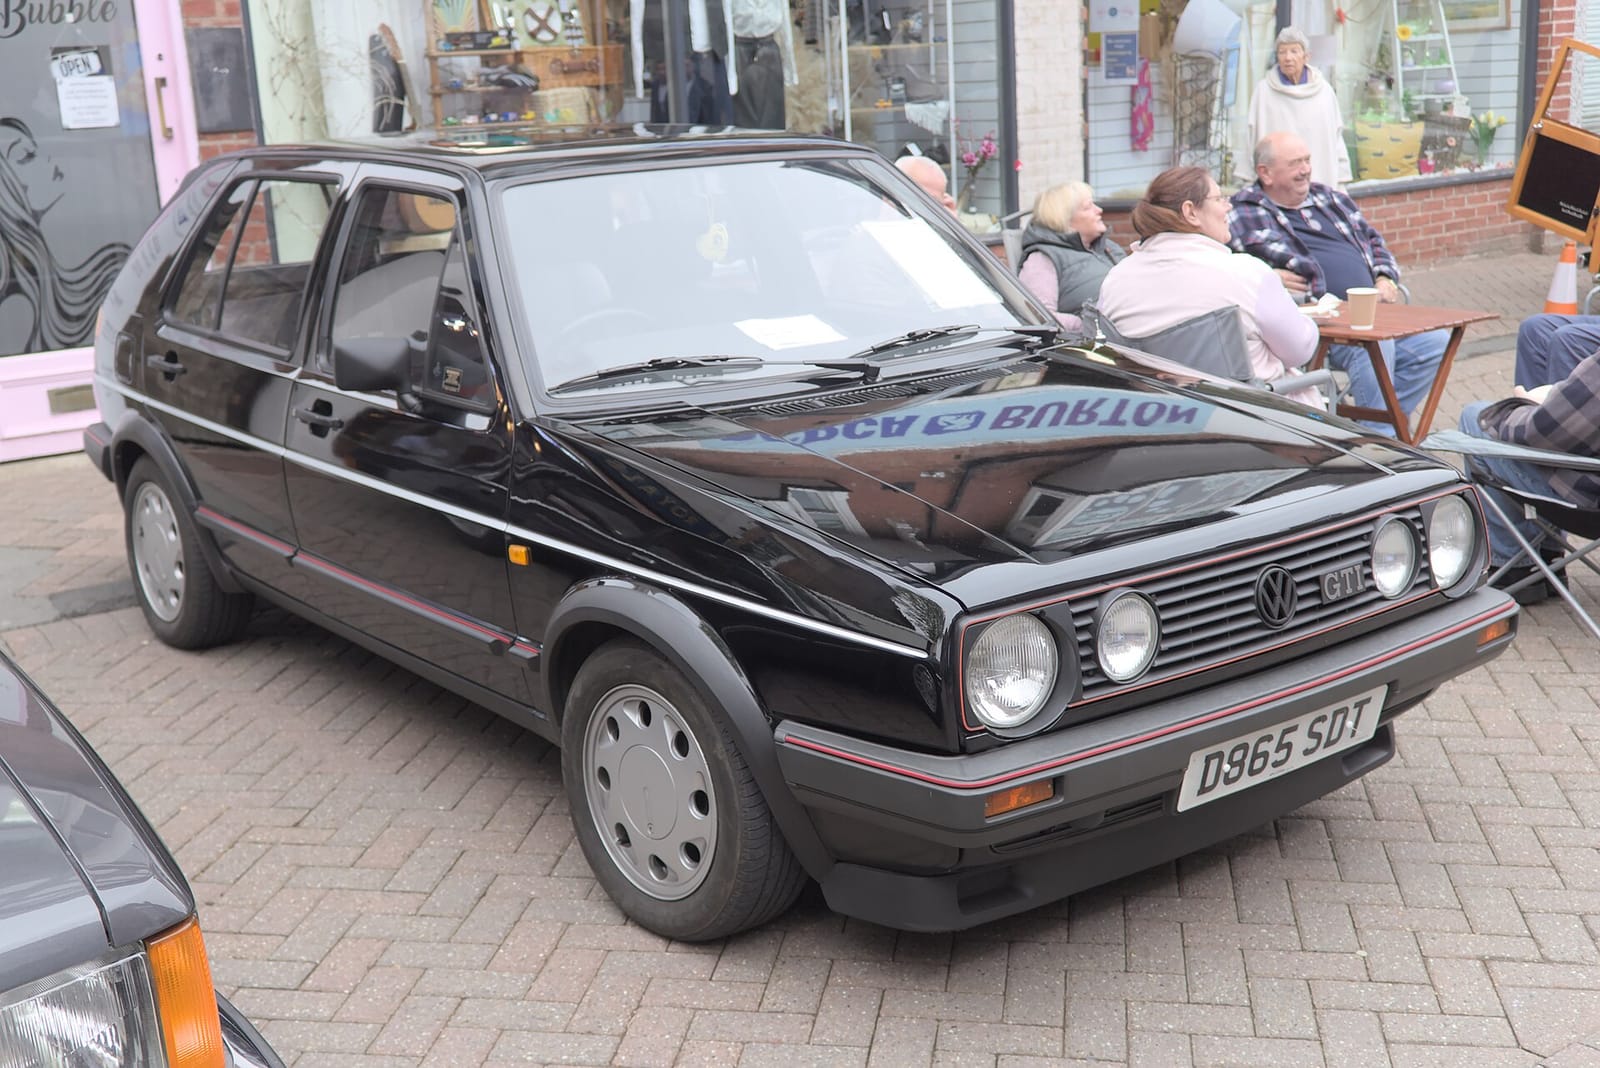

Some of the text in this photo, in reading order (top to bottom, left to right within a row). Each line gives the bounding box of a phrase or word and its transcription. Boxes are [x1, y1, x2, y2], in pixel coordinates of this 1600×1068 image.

[0, 0, 117, 39] Bubble
[60, 55, 92, 77] OPEN
[1324, 564, 1365, 600] GTI
[1196, 697, 1372, 797] D865 SDT
